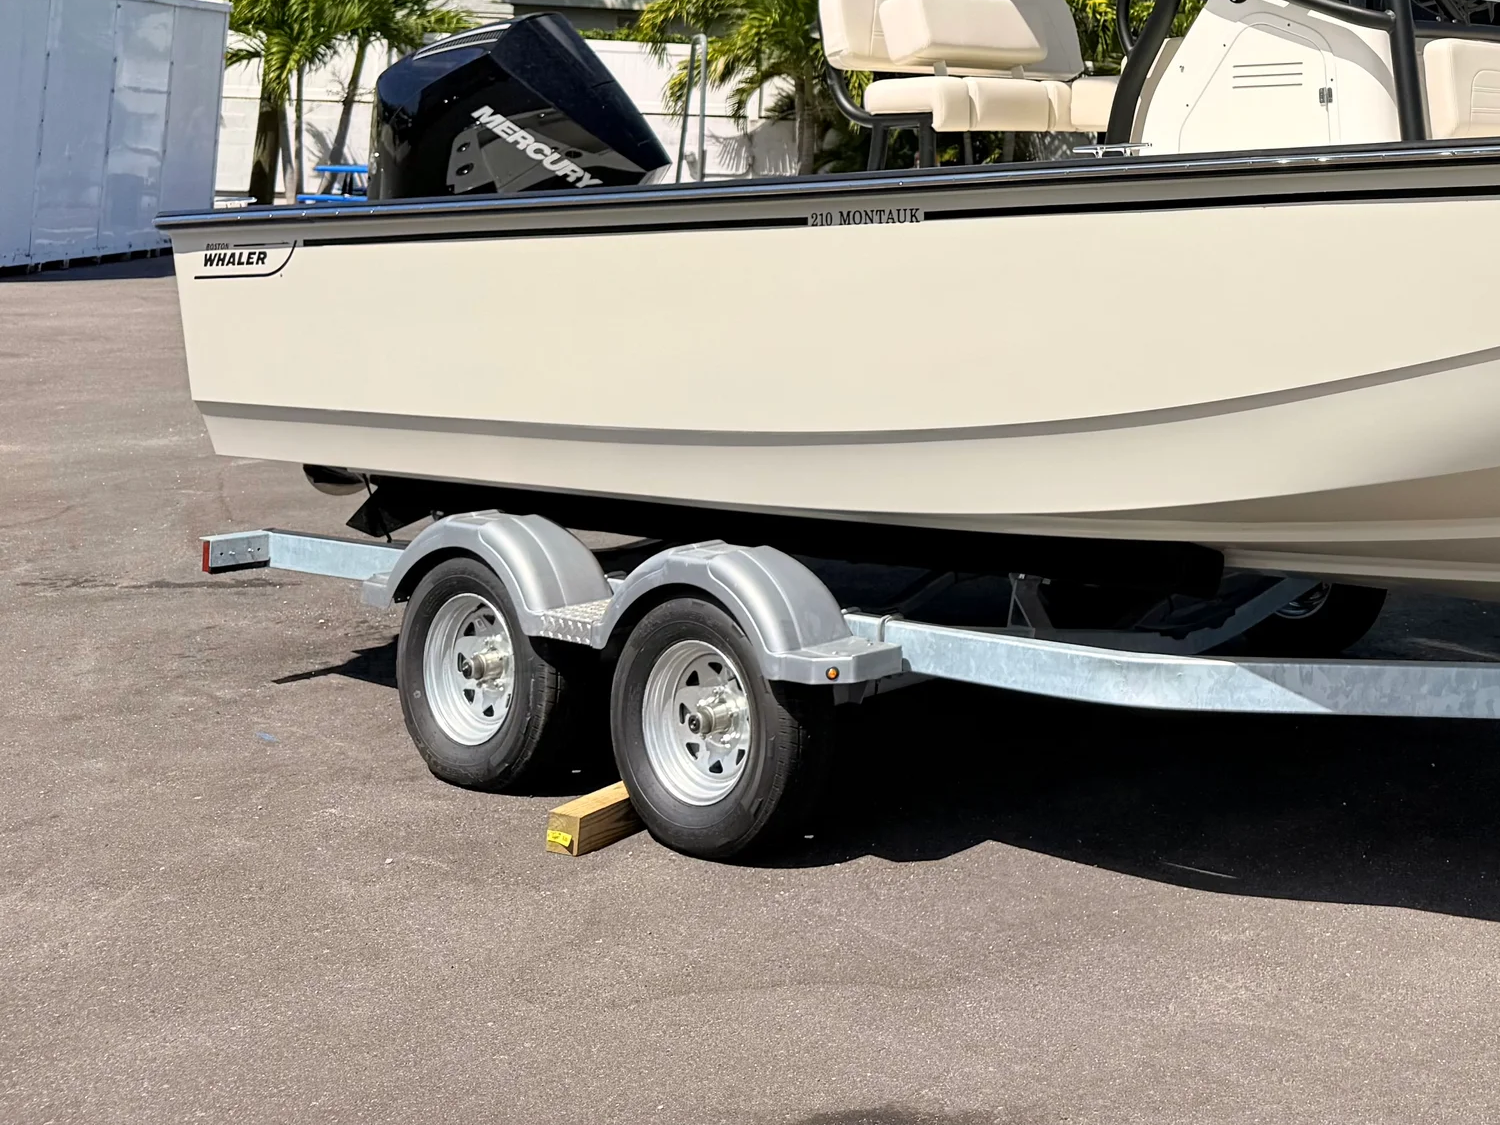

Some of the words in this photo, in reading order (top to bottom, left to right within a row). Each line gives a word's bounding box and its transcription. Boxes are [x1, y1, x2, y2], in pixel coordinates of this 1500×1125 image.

[470, 105, 603, 188] MERCURY
[811, 212, 833, 226] 210
[838, 208, 920, 225] MONTAUK
[205, 242, 229, 251] BOSTON
[203, 251, 267, 267] WHALER
